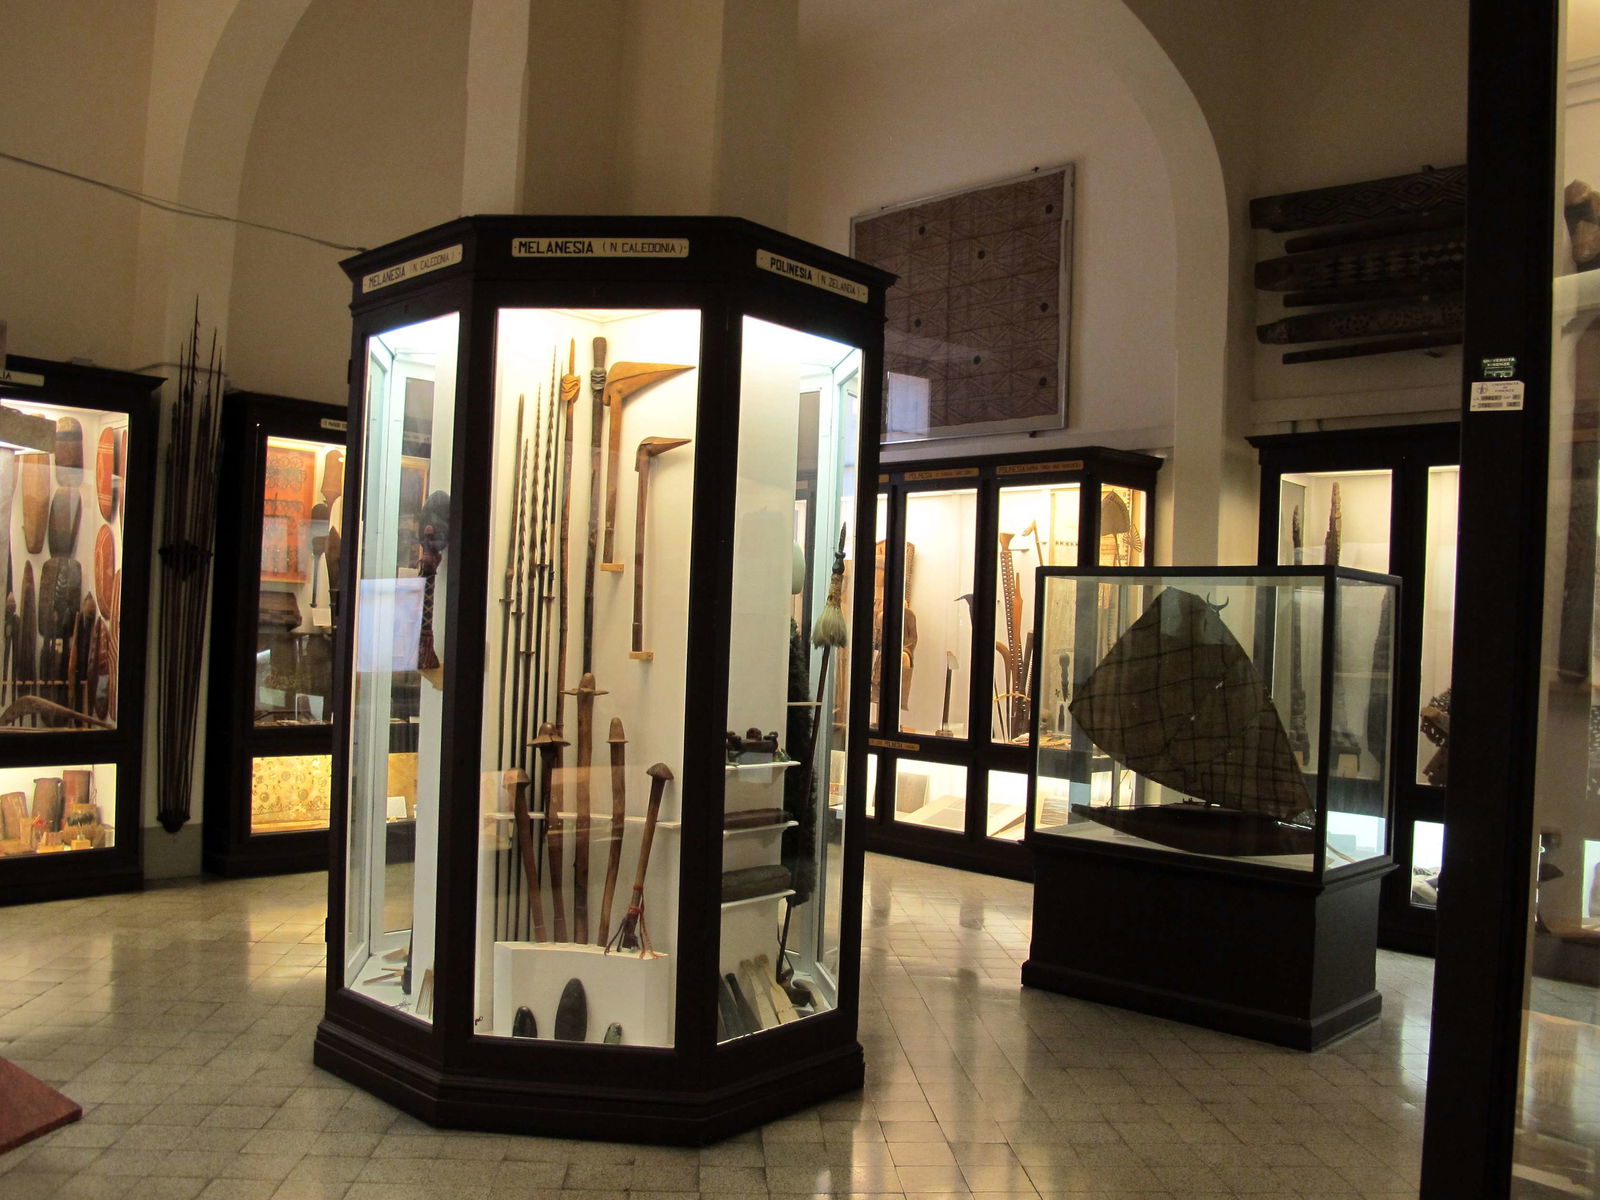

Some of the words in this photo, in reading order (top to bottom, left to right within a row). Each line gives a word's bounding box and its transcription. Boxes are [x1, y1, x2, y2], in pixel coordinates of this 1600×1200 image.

[518, 241, 594, 254] MELANESIA
[368, 265, 406, 289] MELANESIA
[770, 256, 813, 282] POLINESIA
